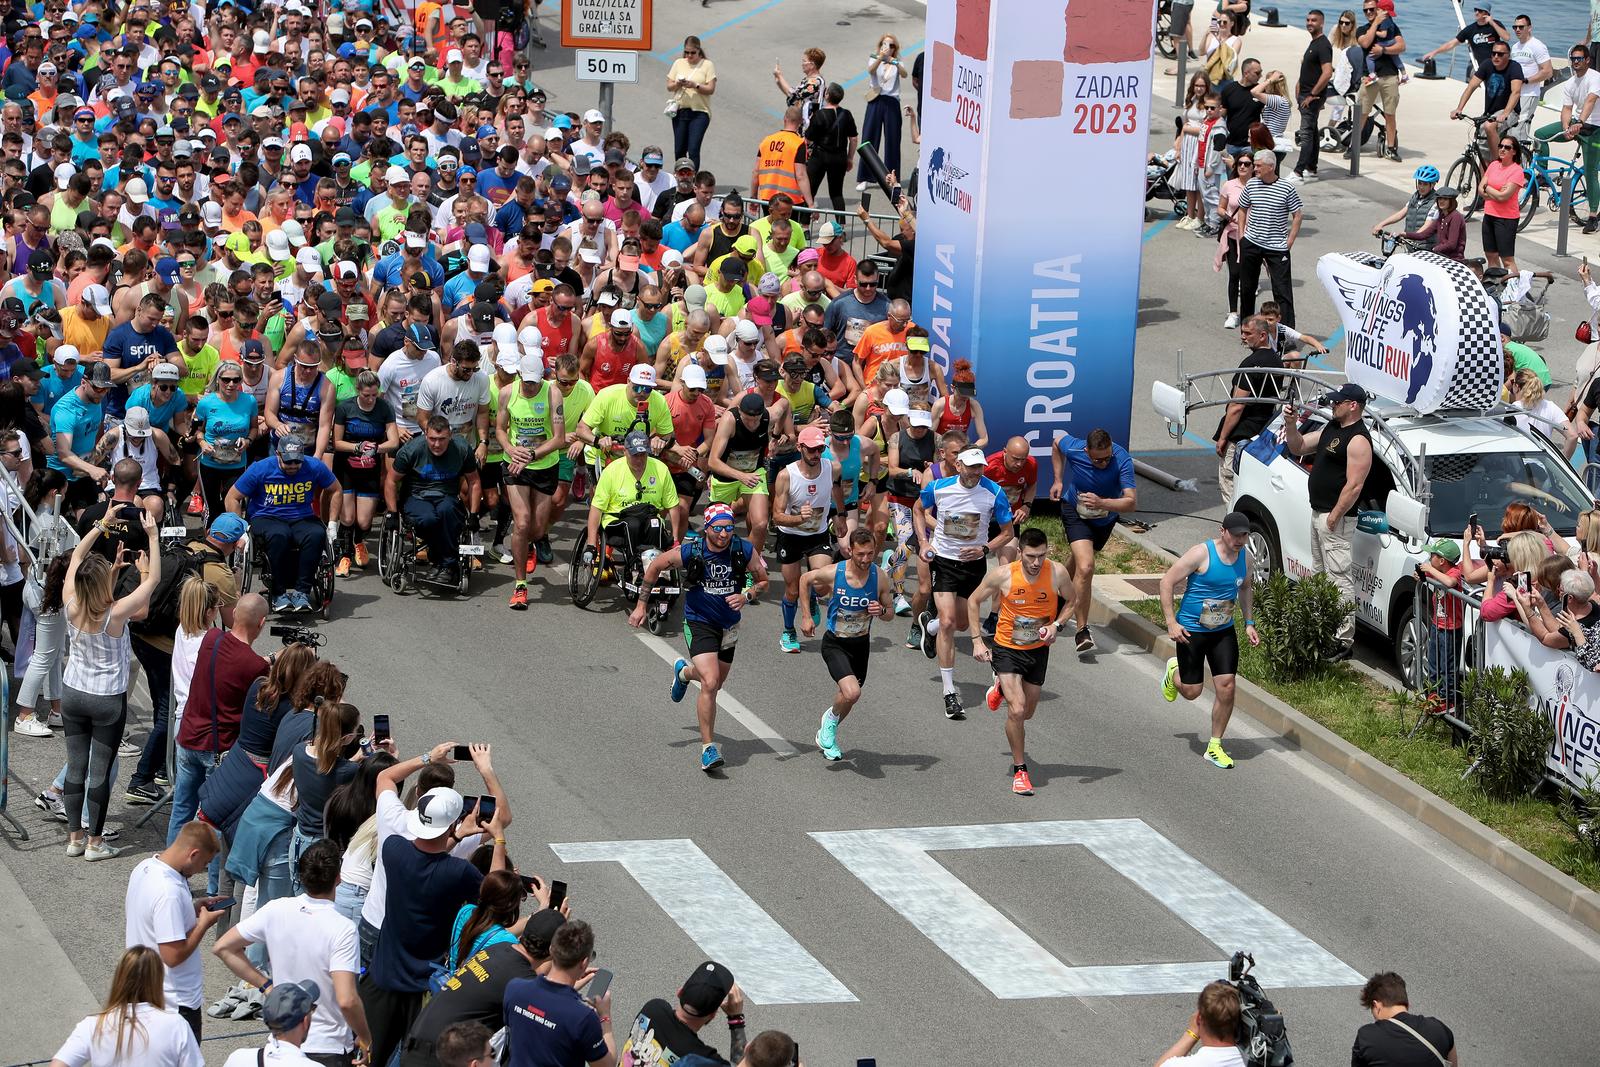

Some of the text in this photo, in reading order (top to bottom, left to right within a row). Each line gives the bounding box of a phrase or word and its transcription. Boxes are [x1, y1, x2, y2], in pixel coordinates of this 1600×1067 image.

[582, 10, 631, 21] VOZILA SA
[579, 23, 634, 35] GRAIŠTA
[588, 59, 626, 74] 50 m
[958, 66, 983, 98] ZADAR
[1075, 75, 1139, 99] ZADAR
[955, 94, 981, 134] 2023
[1073, 103, 1138, 134] 2023
[1362, 288, 1406, 323] WINGS
[1361, 313, 1389, 340] LIFE
[1024, 254, 1082, 457] CROATIA
[264, 481, 312, 495] WINGS
[273, 493, 305, 505] LIFE
[1362, 515, 1383, 523] allwyn
[840, 596, 869, 607] GEO
[1363, 601, 1383, 624] MOGU
[550, 818, 1365, 1005] 10
